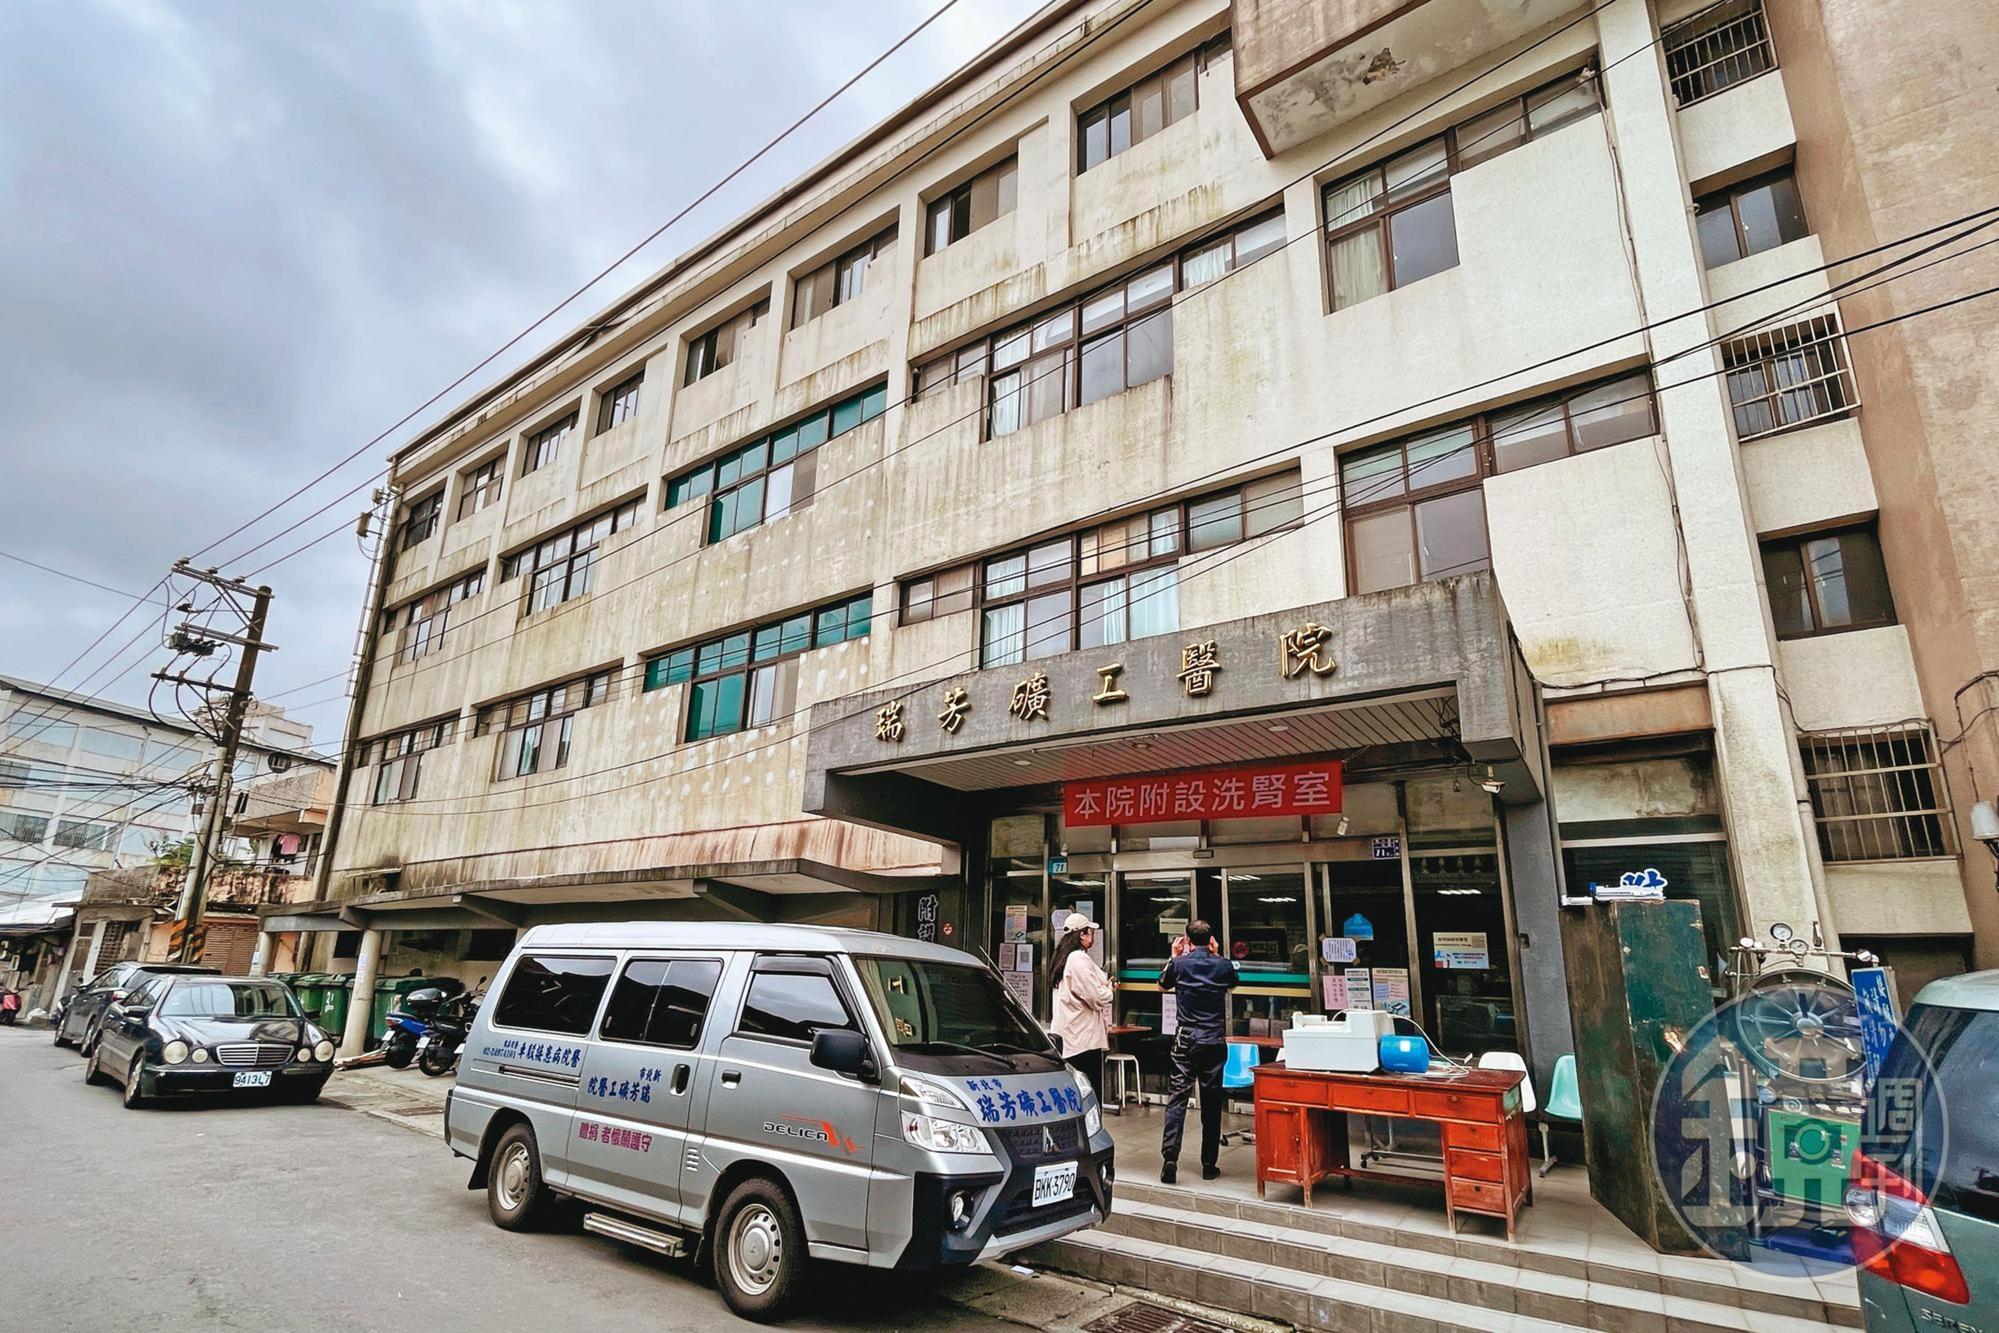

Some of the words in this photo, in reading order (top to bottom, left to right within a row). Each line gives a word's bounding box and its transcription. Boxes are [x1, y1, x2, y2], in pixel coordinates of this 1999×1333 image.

[874, 622, 1337, 743] 瑞芳礦工醫院
[1074, 771, 1331, 819] 本院附設洗腎室
[977, 1087, 1083, 1122] 瑞芳礦工醫院
[764, 1121, 829, 1142] DELICA
